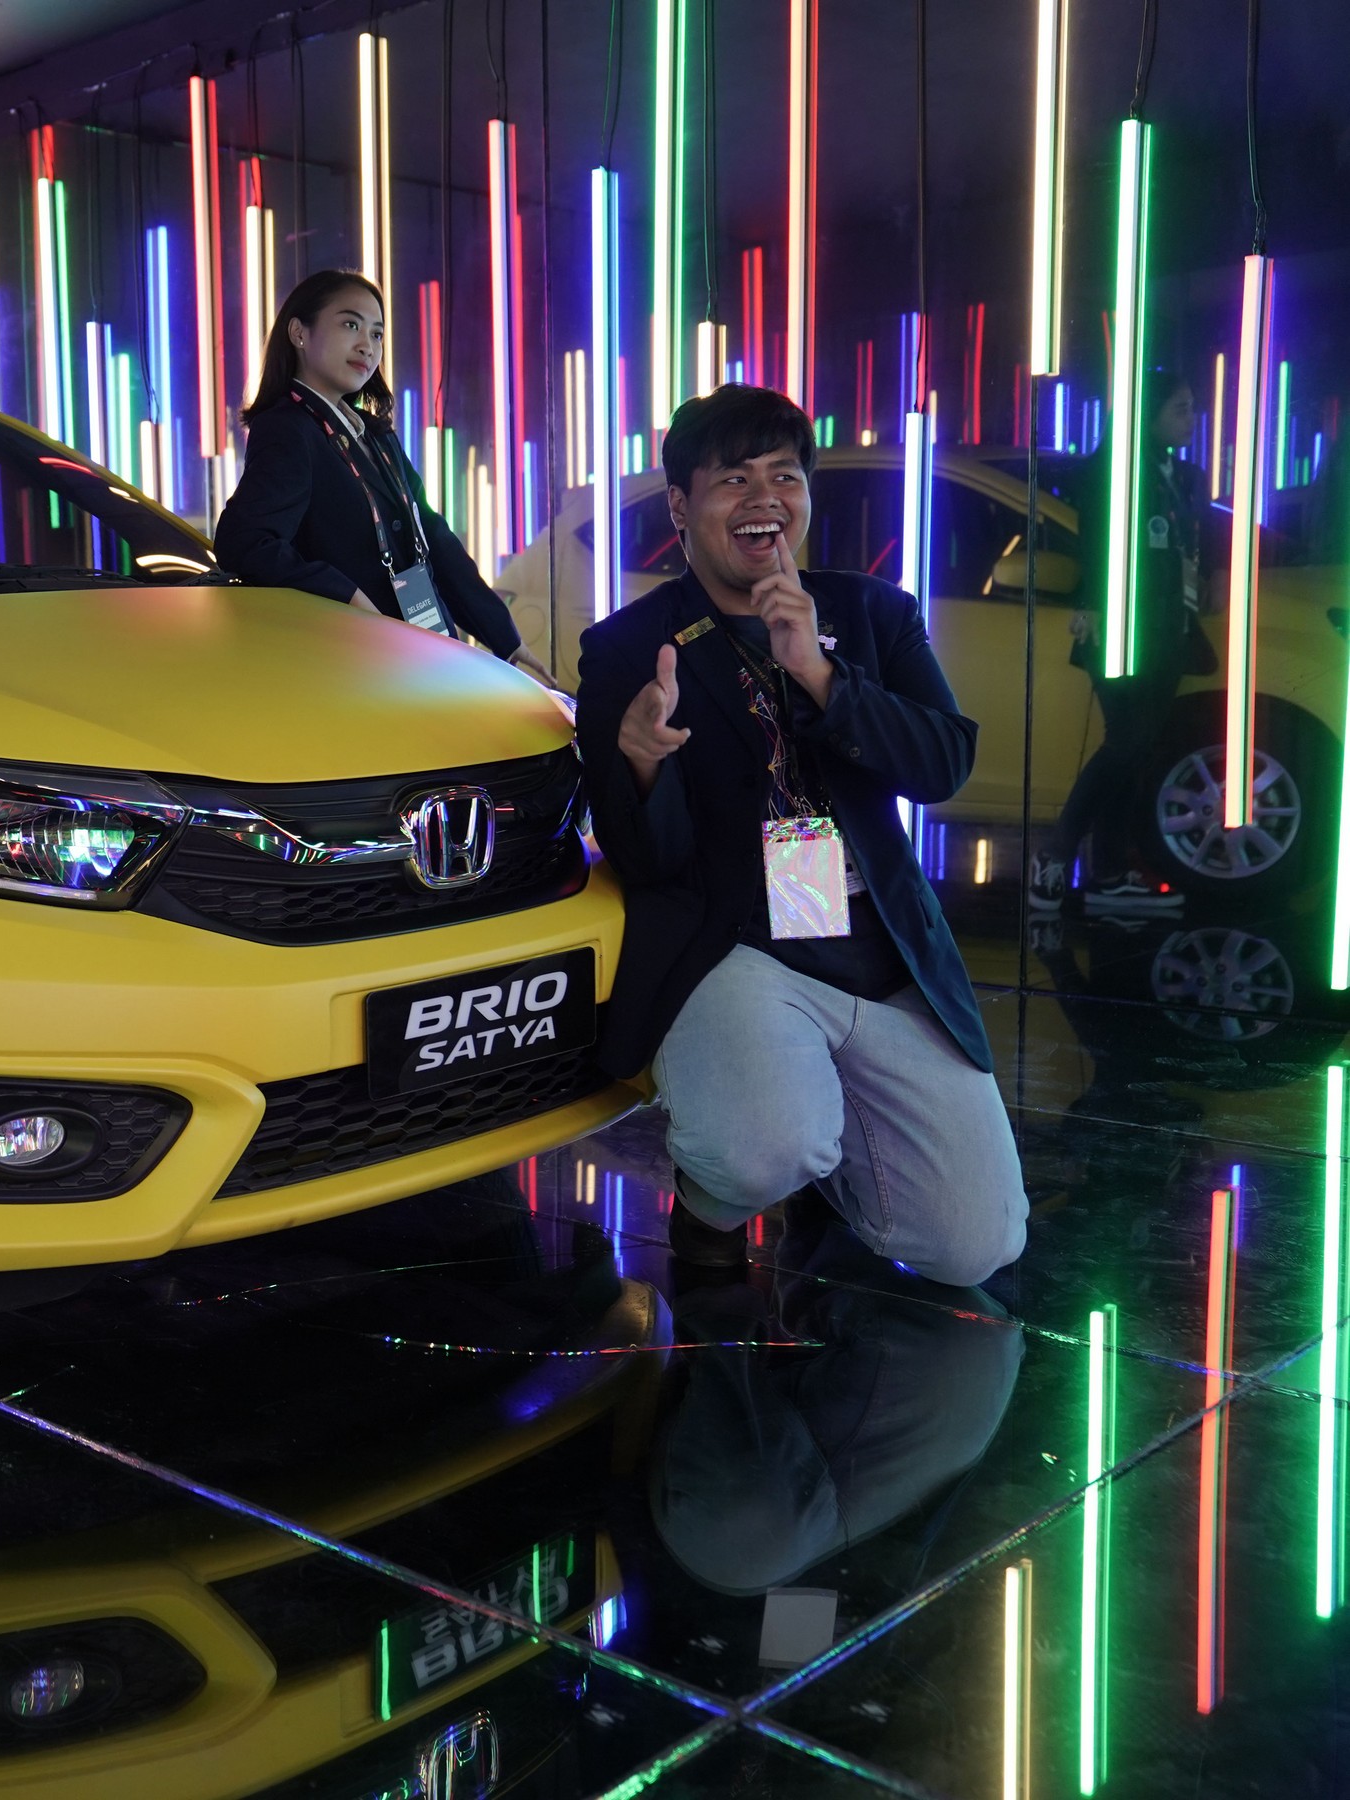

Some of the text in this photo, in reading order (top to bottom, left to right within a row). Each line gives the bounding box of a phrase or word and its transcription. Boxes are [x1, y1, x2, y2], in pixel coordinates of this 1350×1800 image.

[407, 598, 432, 615] DELEGATE
[404, 971, 568, 1040] BRIO
[415, 1016, 556, 1072] SATYA
